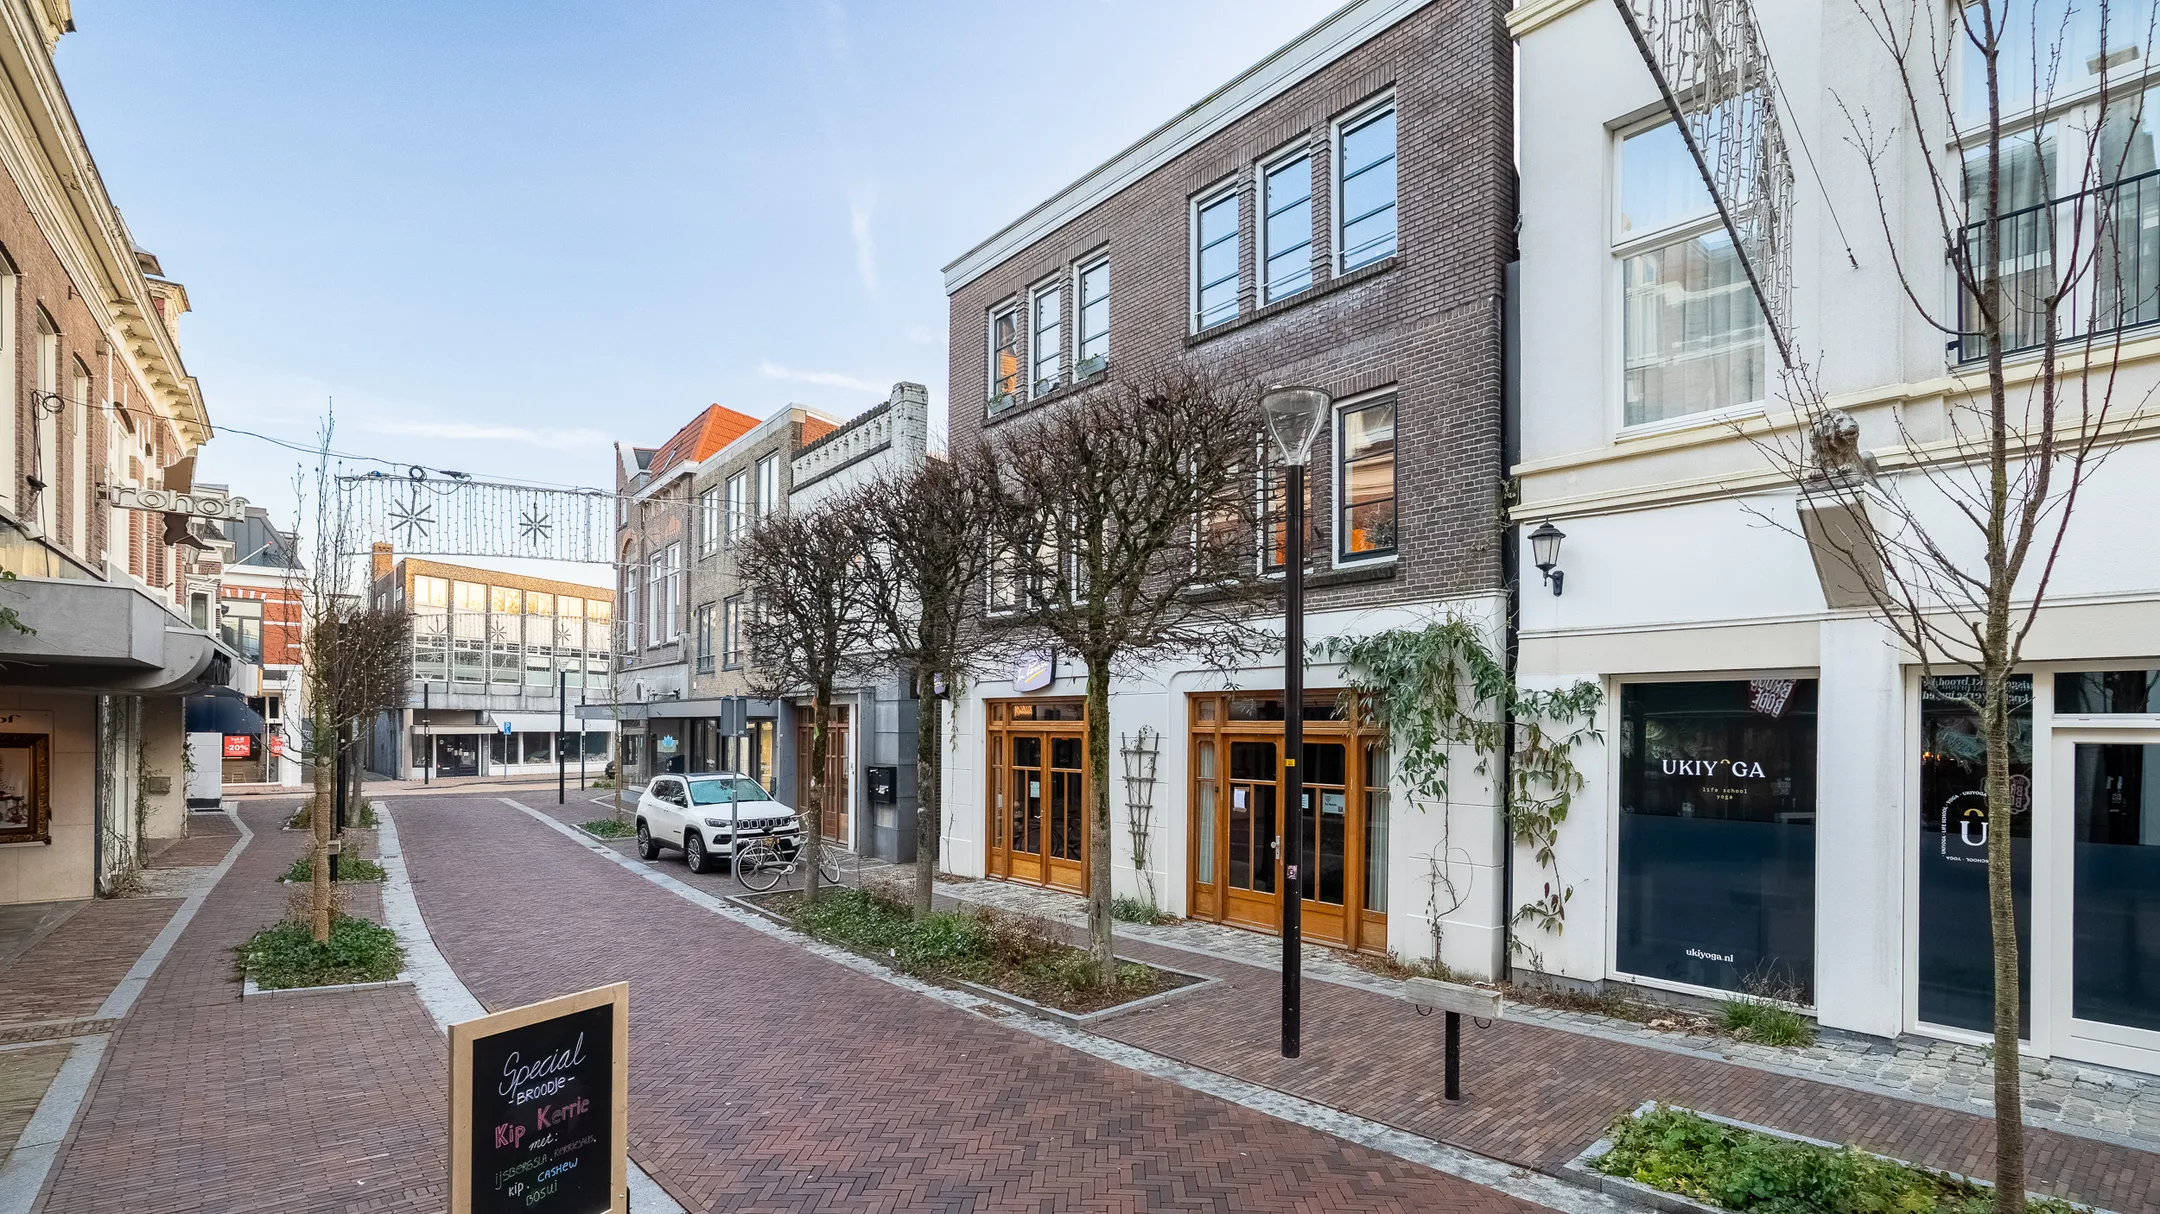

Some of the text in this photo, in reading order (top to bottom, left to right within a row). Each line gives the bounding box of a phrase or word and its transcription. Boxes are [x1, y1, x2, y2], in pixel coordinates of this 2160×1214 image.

[1723, 787, 1748, 795] school
[1946, 794, 1960, 805] YOGA
[1685, 948, 1734, 963] ukiyoga.nl
[498, 1031, 587, 1099] Special
[495, 1096, 590, 1149] Kip Kerrie
